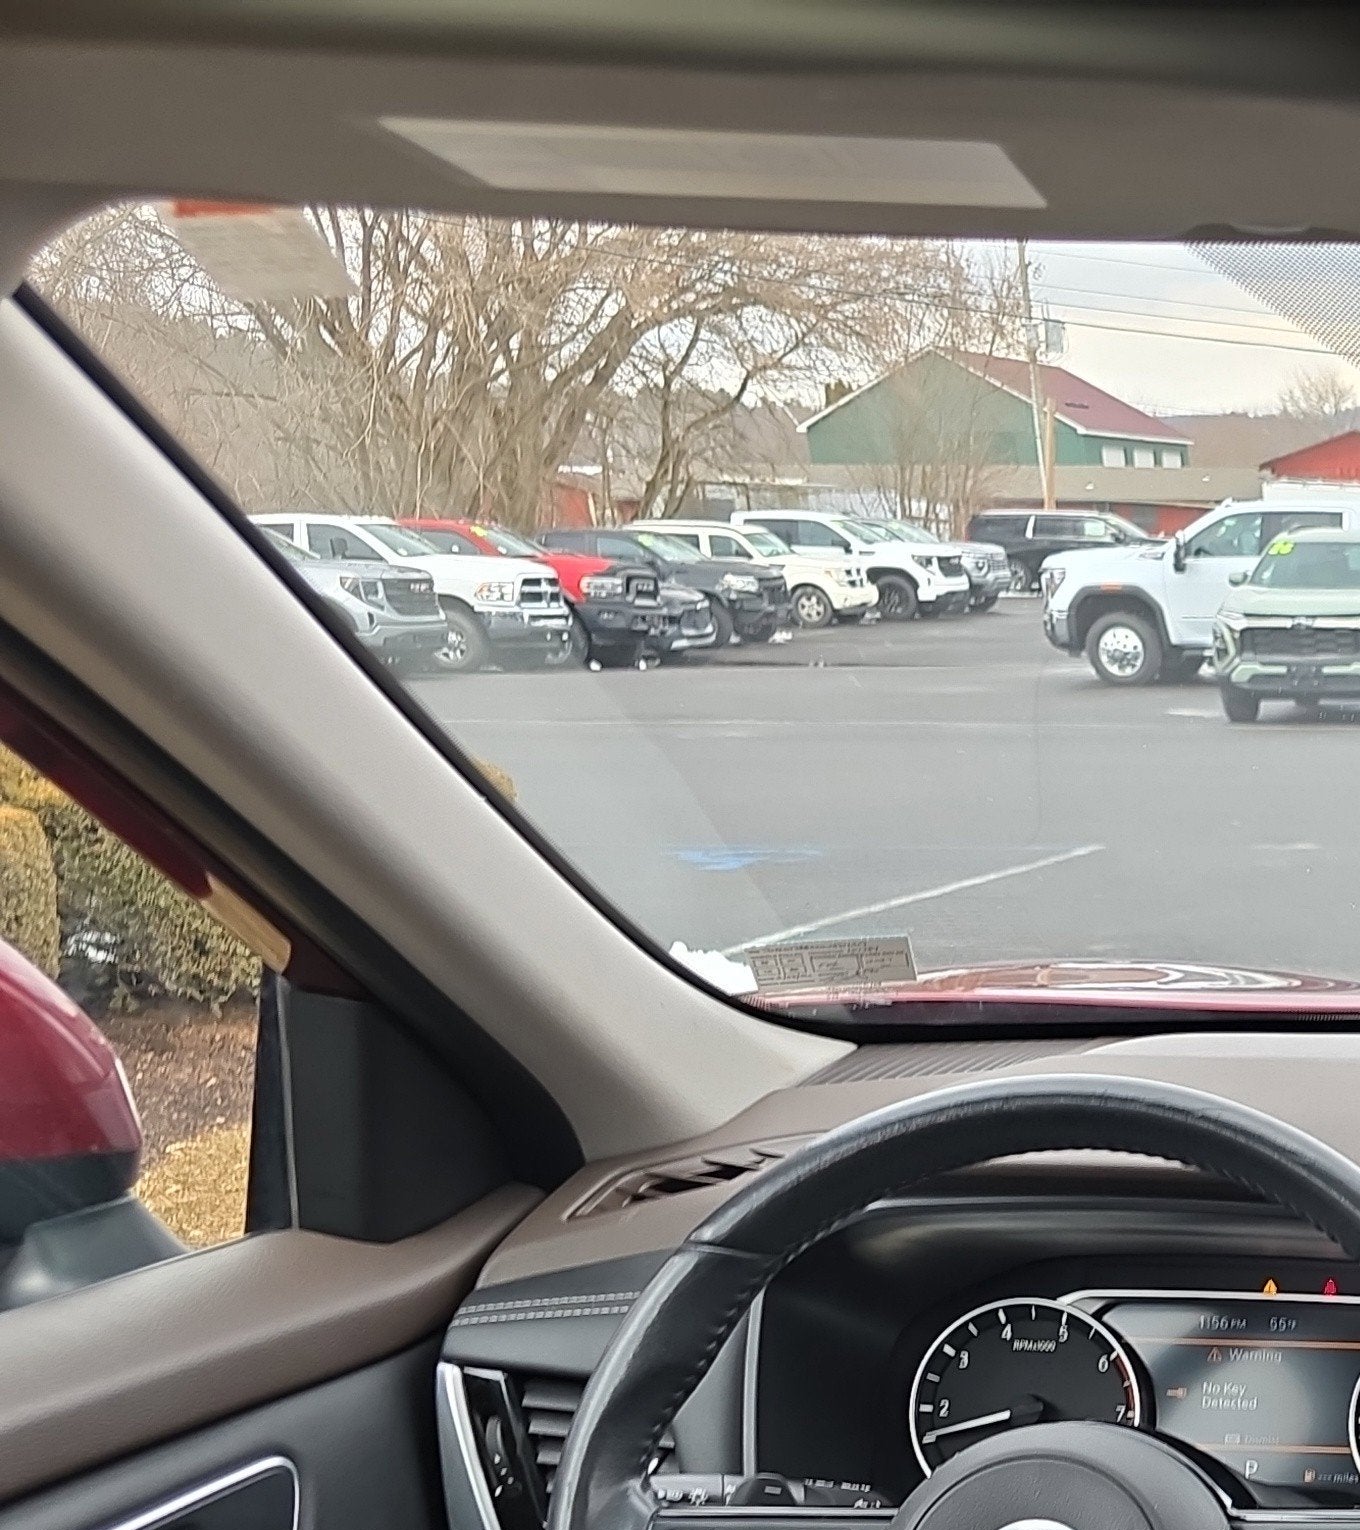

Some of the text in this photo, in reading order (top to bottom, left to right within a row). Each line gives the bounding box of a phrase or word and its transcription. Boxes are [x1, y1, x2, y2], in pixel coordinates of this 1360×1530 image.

[1001, 1323, 1013, 1341] 4
[958, 1350, 970, 1370] 3
[1097, 1355, 1110, 1373] 6
[1229, 1348, 1282, 1363] Warning
[1203, 1381, 1247, 1400] No Key
[938, 1398, 951, 1418] 2
[1201, 1396, 1258, 1411] Detected
[1115, 1404, 1127, 1423] 7
[1245, 1459, 1259, 1480] P
